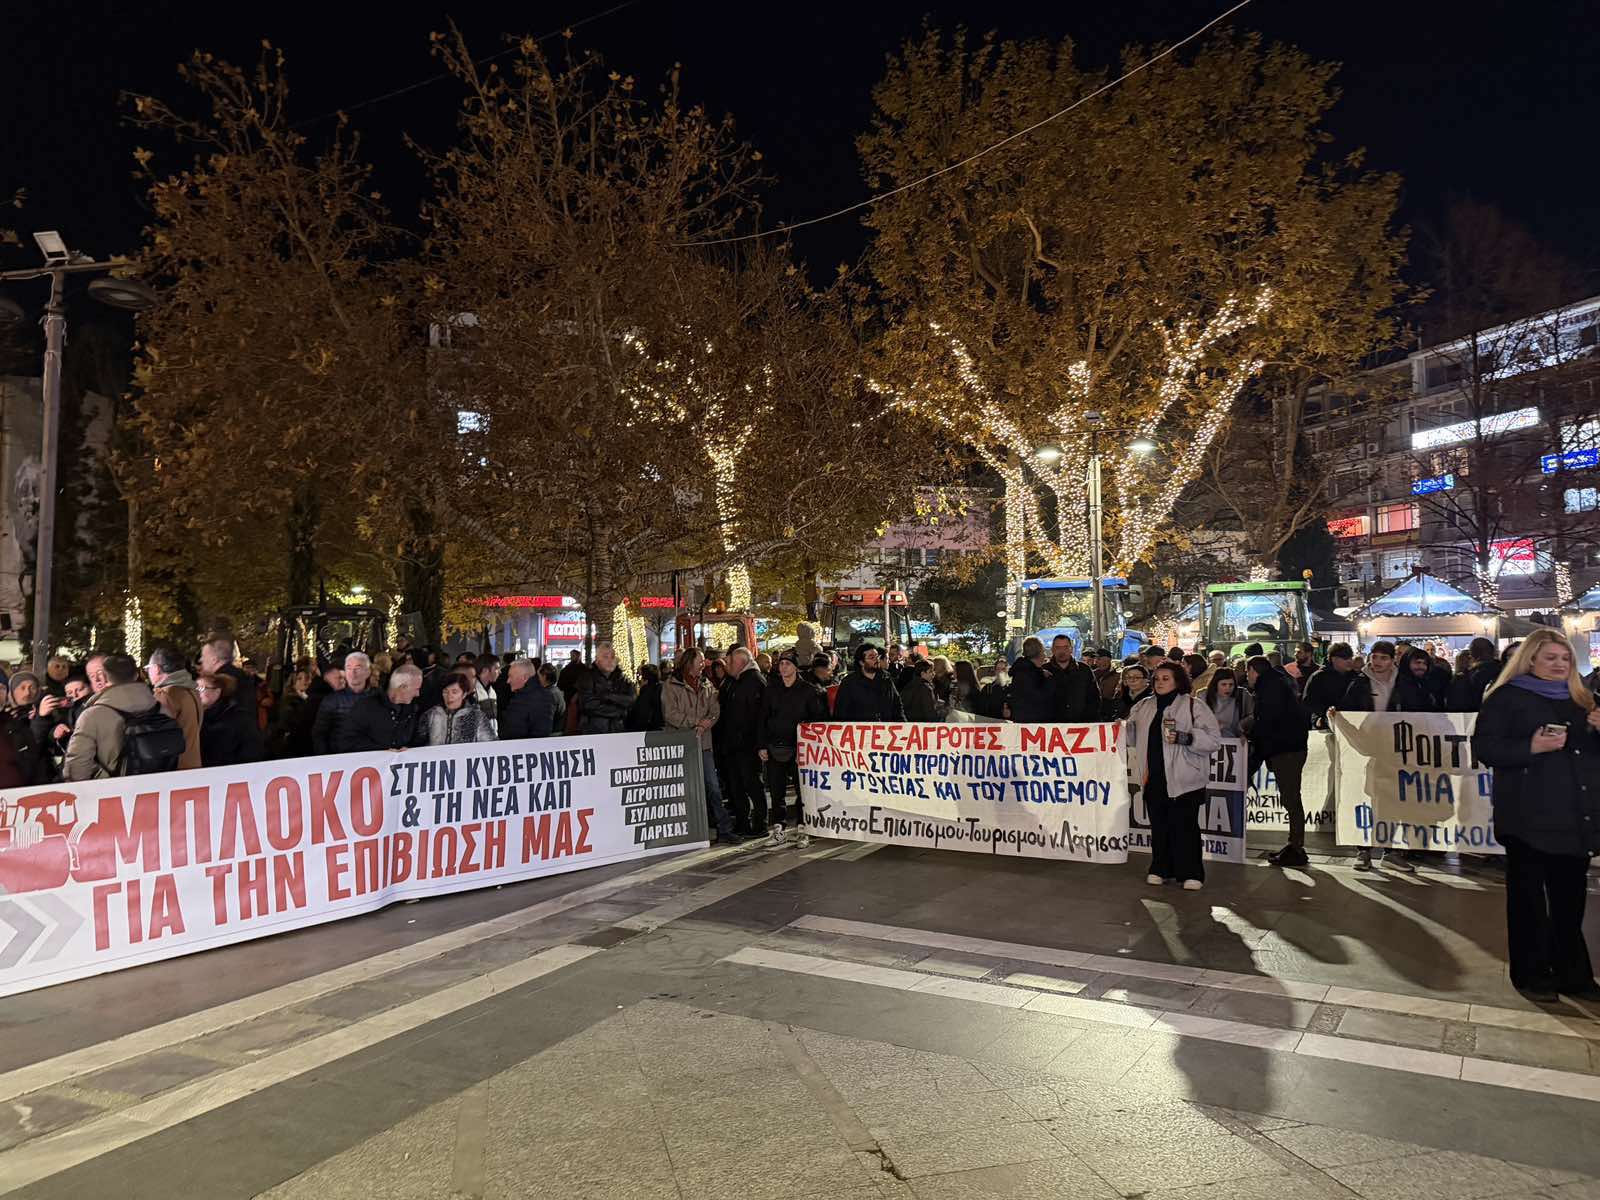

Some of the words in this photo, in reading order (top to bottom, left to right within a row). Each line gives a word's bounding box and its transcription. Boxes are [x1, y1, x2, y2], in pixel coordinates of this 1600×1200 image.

[639, 744, 684, 762] ΕΝΩΤΙΚΗ
[797, 742, 869, 771] ΕΝΑΝΤΙΑ
[868, 752, 912, 774] ΣΤΟΝ
[390, 759, 456, 797] ΣΤΗΝ
[466, 748, 596, 789] ΚΥΒΕΡΝΗΣΗ
[614, 763, 684, 784] ΟΜΟΣΠΟΝΔΙΑ
[800, 769, 831, 790] ΤΗΣ
[841, 769, 929, 799] ΦΤΩΧΕΙΑΣ
[934, 780, 961, 801] ΚΑΙ
[968, 781, 1005, 802] ΤΟΥ
[1010, 780, 1110, 806] ΠΟΛΕΜΟΥ
[1398, 769, 1455, 804] ΜΙΑ
[402, 795, 421, 828] &
[432, 791, 462, 824] ΤΗ
[472, 785, 520, 820] ΝΕΑ
[528, 780, 571, 813] ΚΑΠ
[625, 783, 685, 803] ΑΓΡΟΤΙΚΩΝ
[99, 766, 384, 876] ΜΠΛΟΚΟ
[630, 802, 687, 823] ΣΥΛΛΟΓΩΝ
[640, 821, 688, 841] ΛΑΡΙΣΑΣ
[93, 874, 186, 951] ΓΙΑ
[205, 852, 307, 926] ΤΗΝ
[326, 820, 506, 902] ΕΠΙΒΙΩΣΗ
[522, 808, 595, 864] ΜΑΣ
